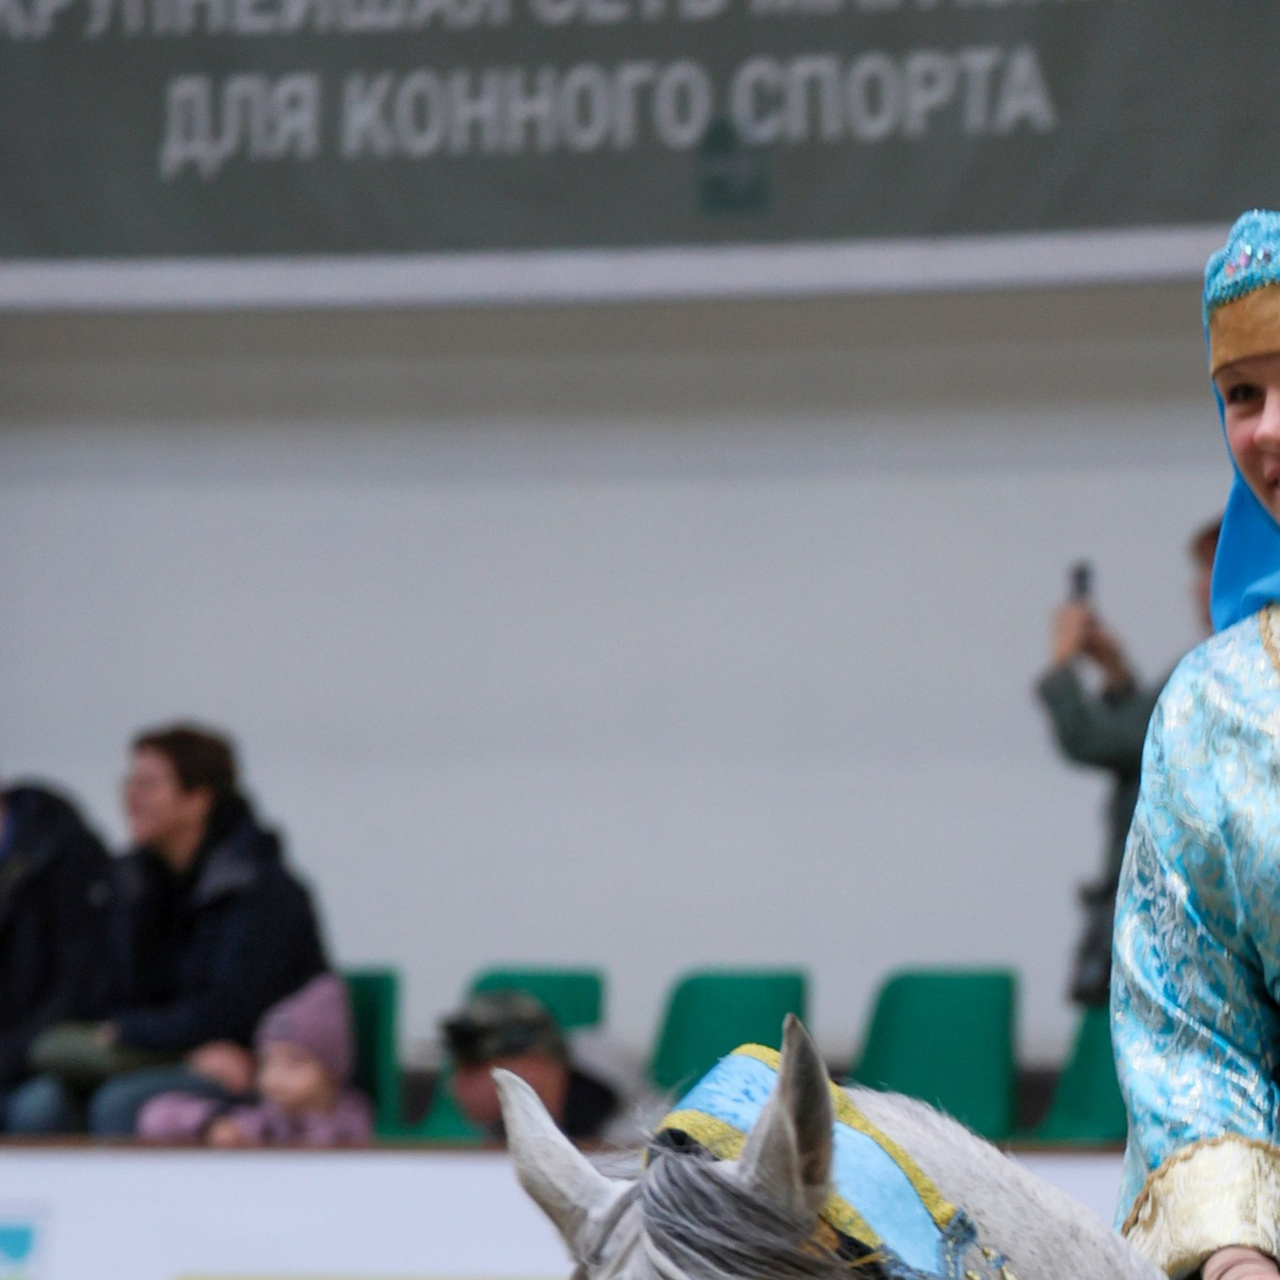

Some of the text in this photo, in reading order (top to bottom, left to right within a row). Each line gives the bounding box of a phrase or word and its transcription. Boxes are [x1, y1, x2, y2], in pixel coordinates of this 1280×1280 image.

[161, 44, 1056, 178] ДЛЯ КОННОГО СПОРТА
